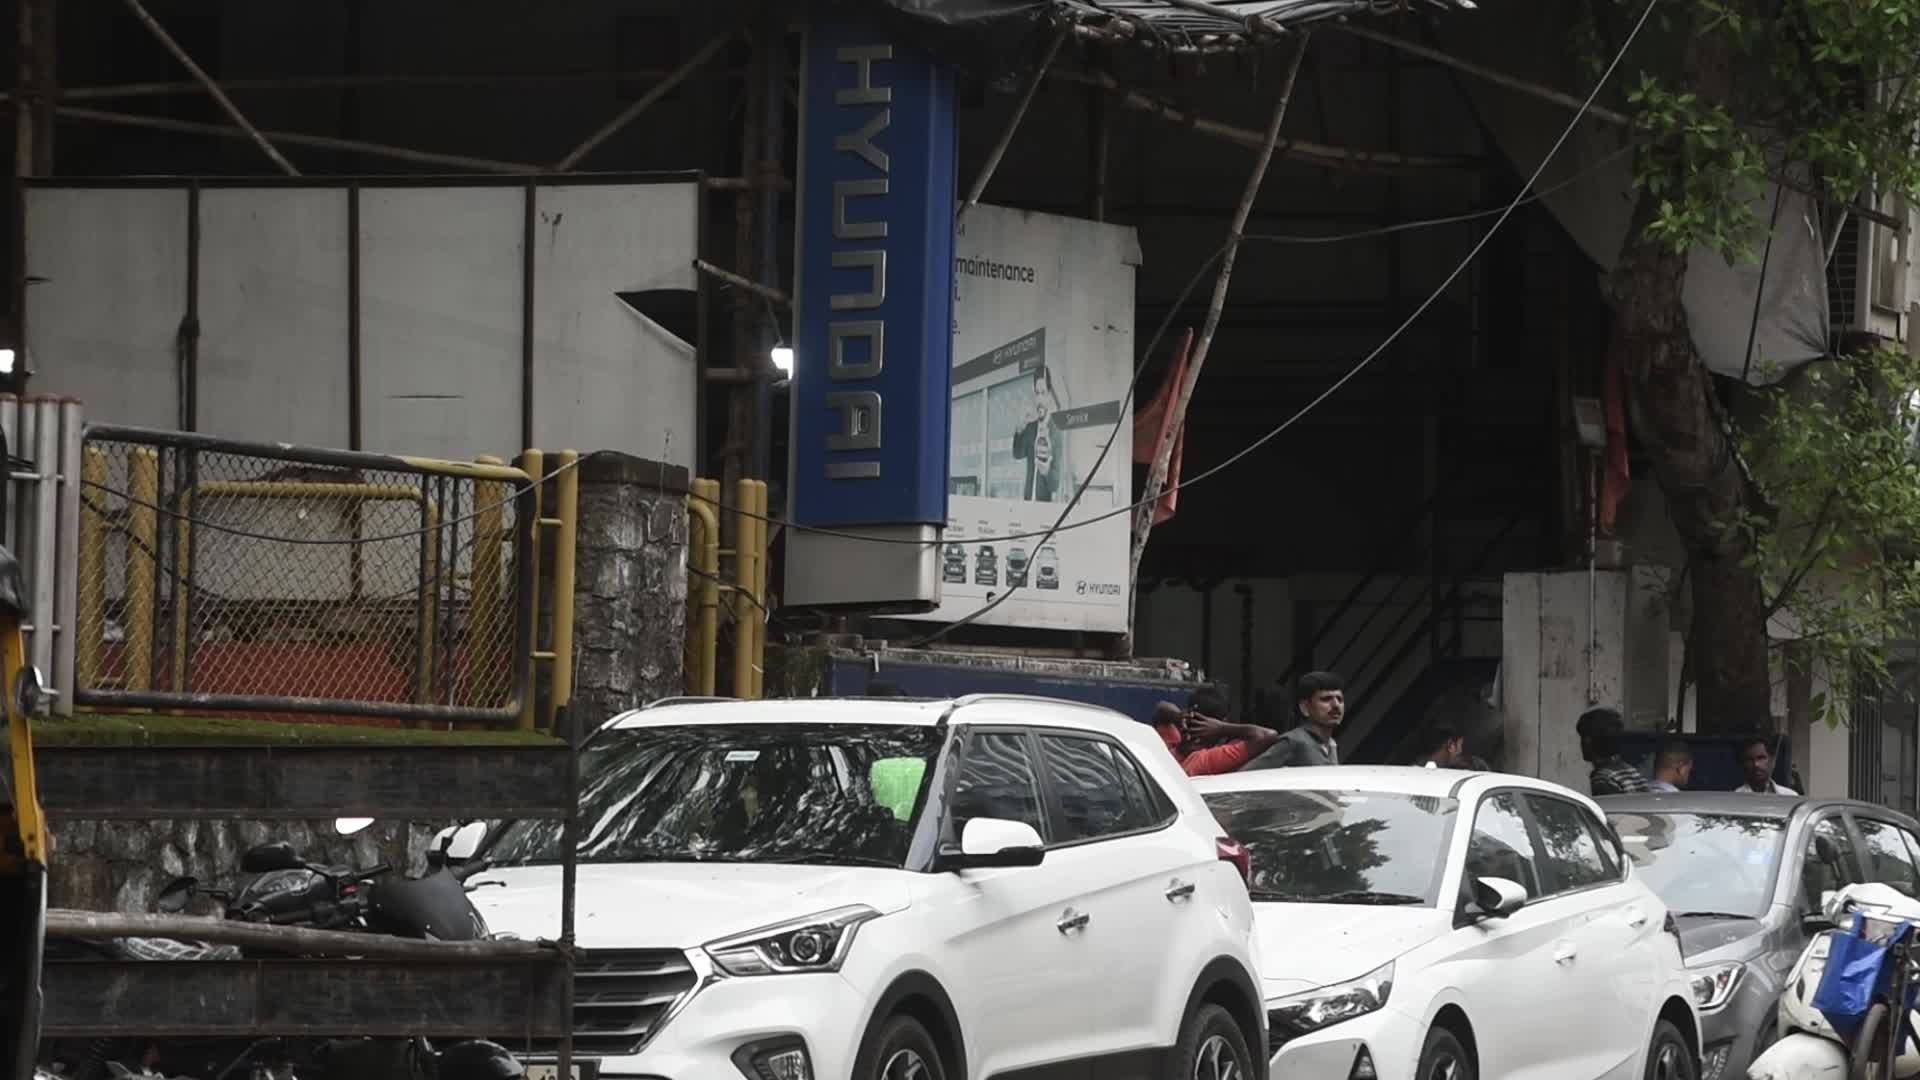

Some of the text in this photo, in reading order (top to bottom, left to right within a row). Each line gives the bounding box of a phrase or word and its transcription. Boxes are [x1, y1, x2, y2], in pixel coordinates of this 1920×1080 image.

[824, 43, 893, 480] HYUNDAI
[955, 255, 1035, 283] maintenance
[1089, 582, 1121, 597] HYUNDAI
